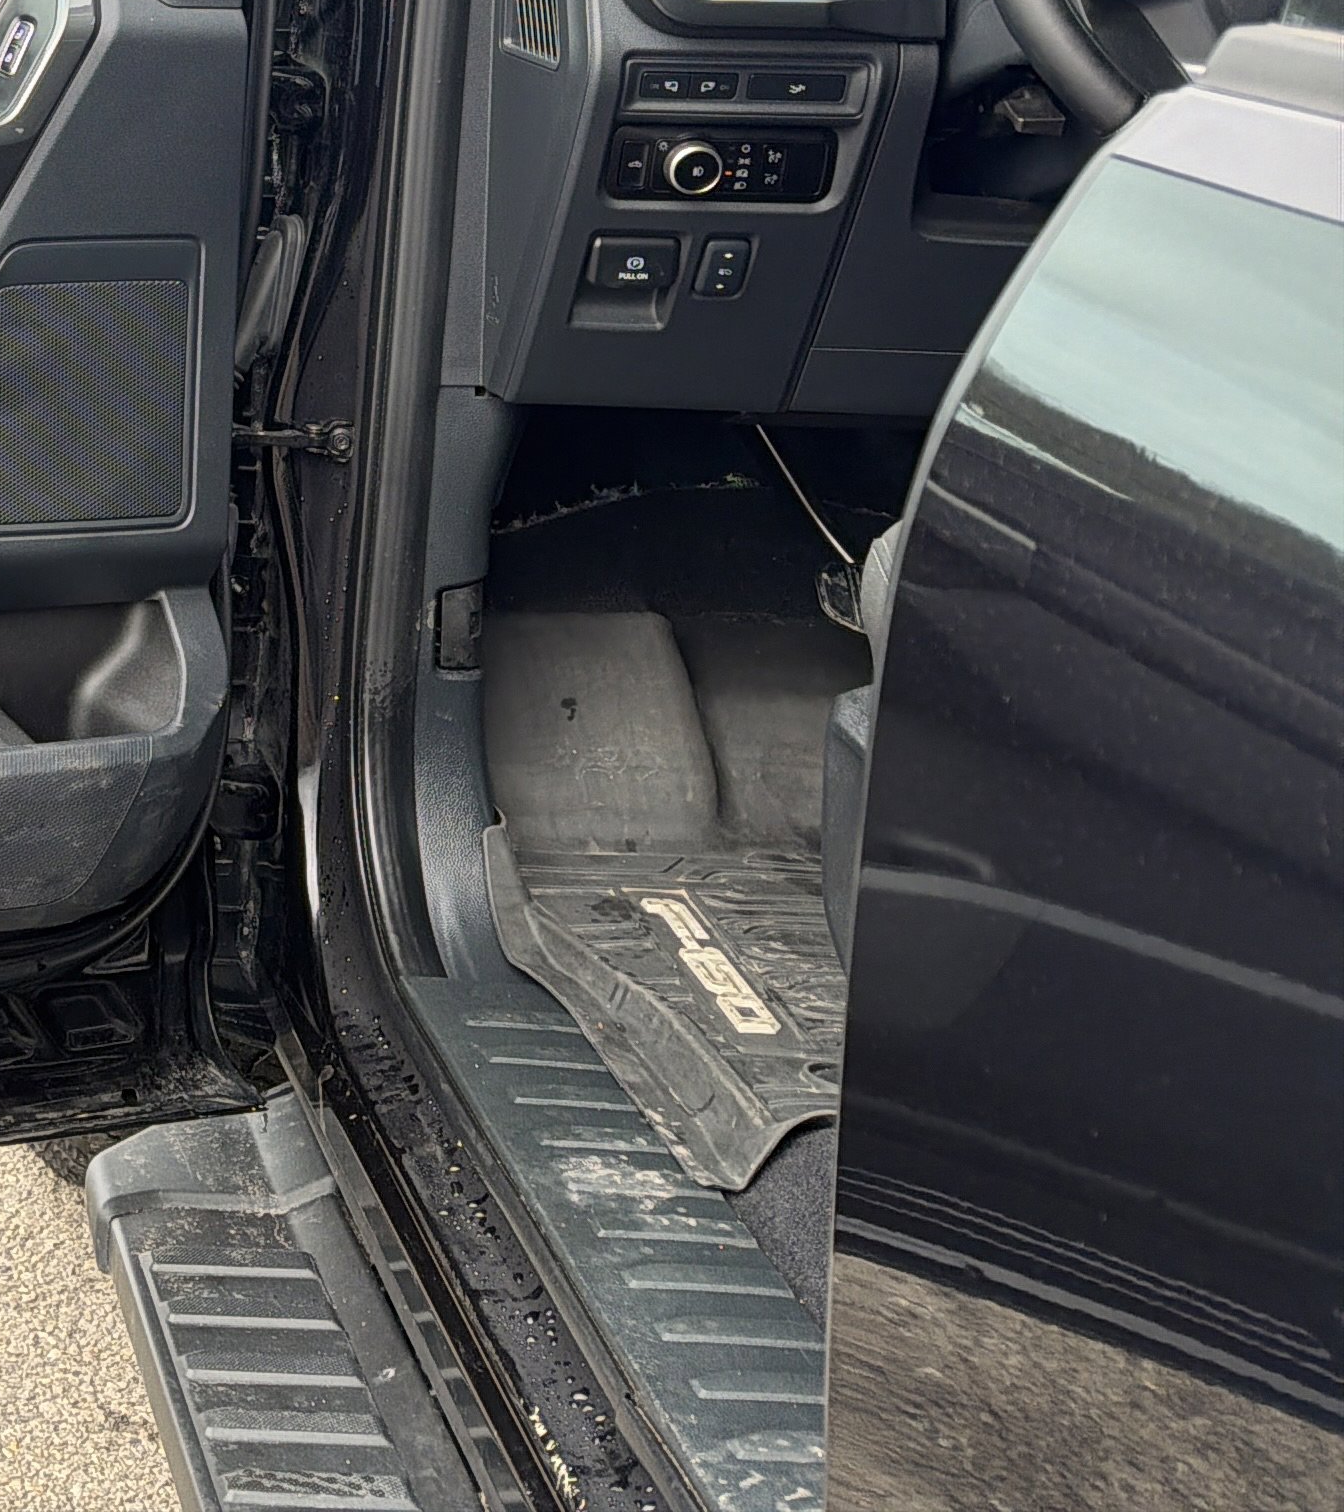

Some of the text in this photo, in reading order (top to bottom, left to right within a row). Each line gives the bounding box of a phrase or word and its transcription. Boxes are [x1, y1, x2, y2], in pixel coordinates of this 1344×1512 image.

[618, 272, 649, 280] PULL ON
[641, 898, 782, 1035] F-150
